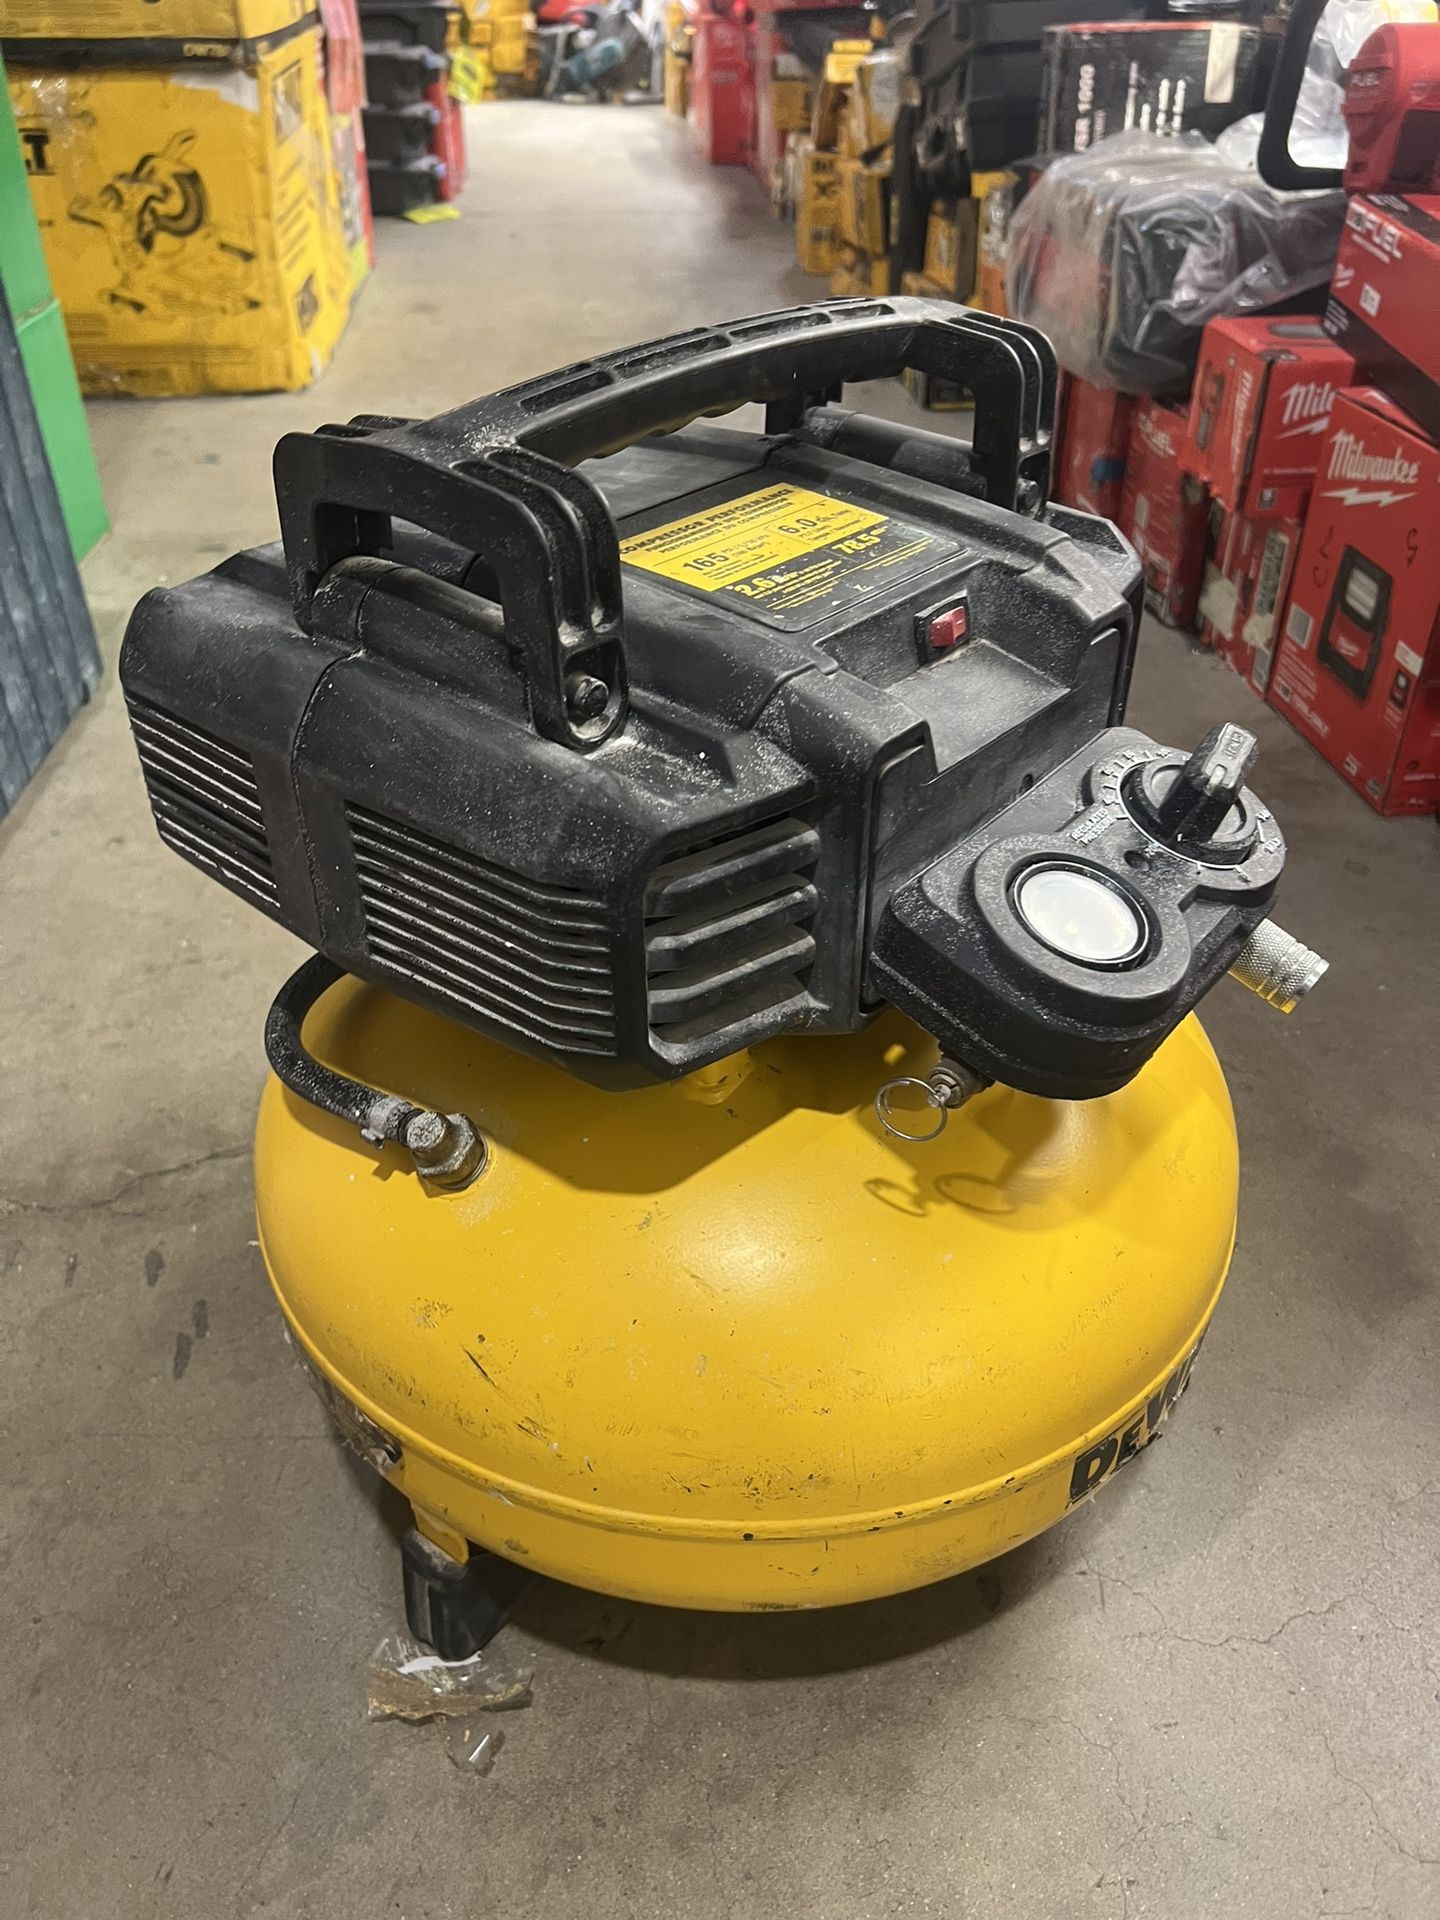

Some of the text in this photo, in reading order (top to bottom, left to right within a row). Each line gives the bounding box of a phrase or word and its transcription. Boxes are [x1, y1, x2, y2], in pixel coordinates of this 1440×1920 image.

[1367, 212, 1403, 260] FUEL
[1328, 428, 1420, 484] Milwaukee
[621, 520, 705, 554] COMPRESSOR
[706, 487, 795, 522] PERFORMANCE
[777, 517, 818, 534] 6.0
[831, 533, 882, 555] 78.5
[683, 552, 729, 571] 165
[734, 577, 777, 597] 2.6
[1070, 807, 1109, 841] REGULATED
[1080, 815, 1116, 846] PRESSURE
